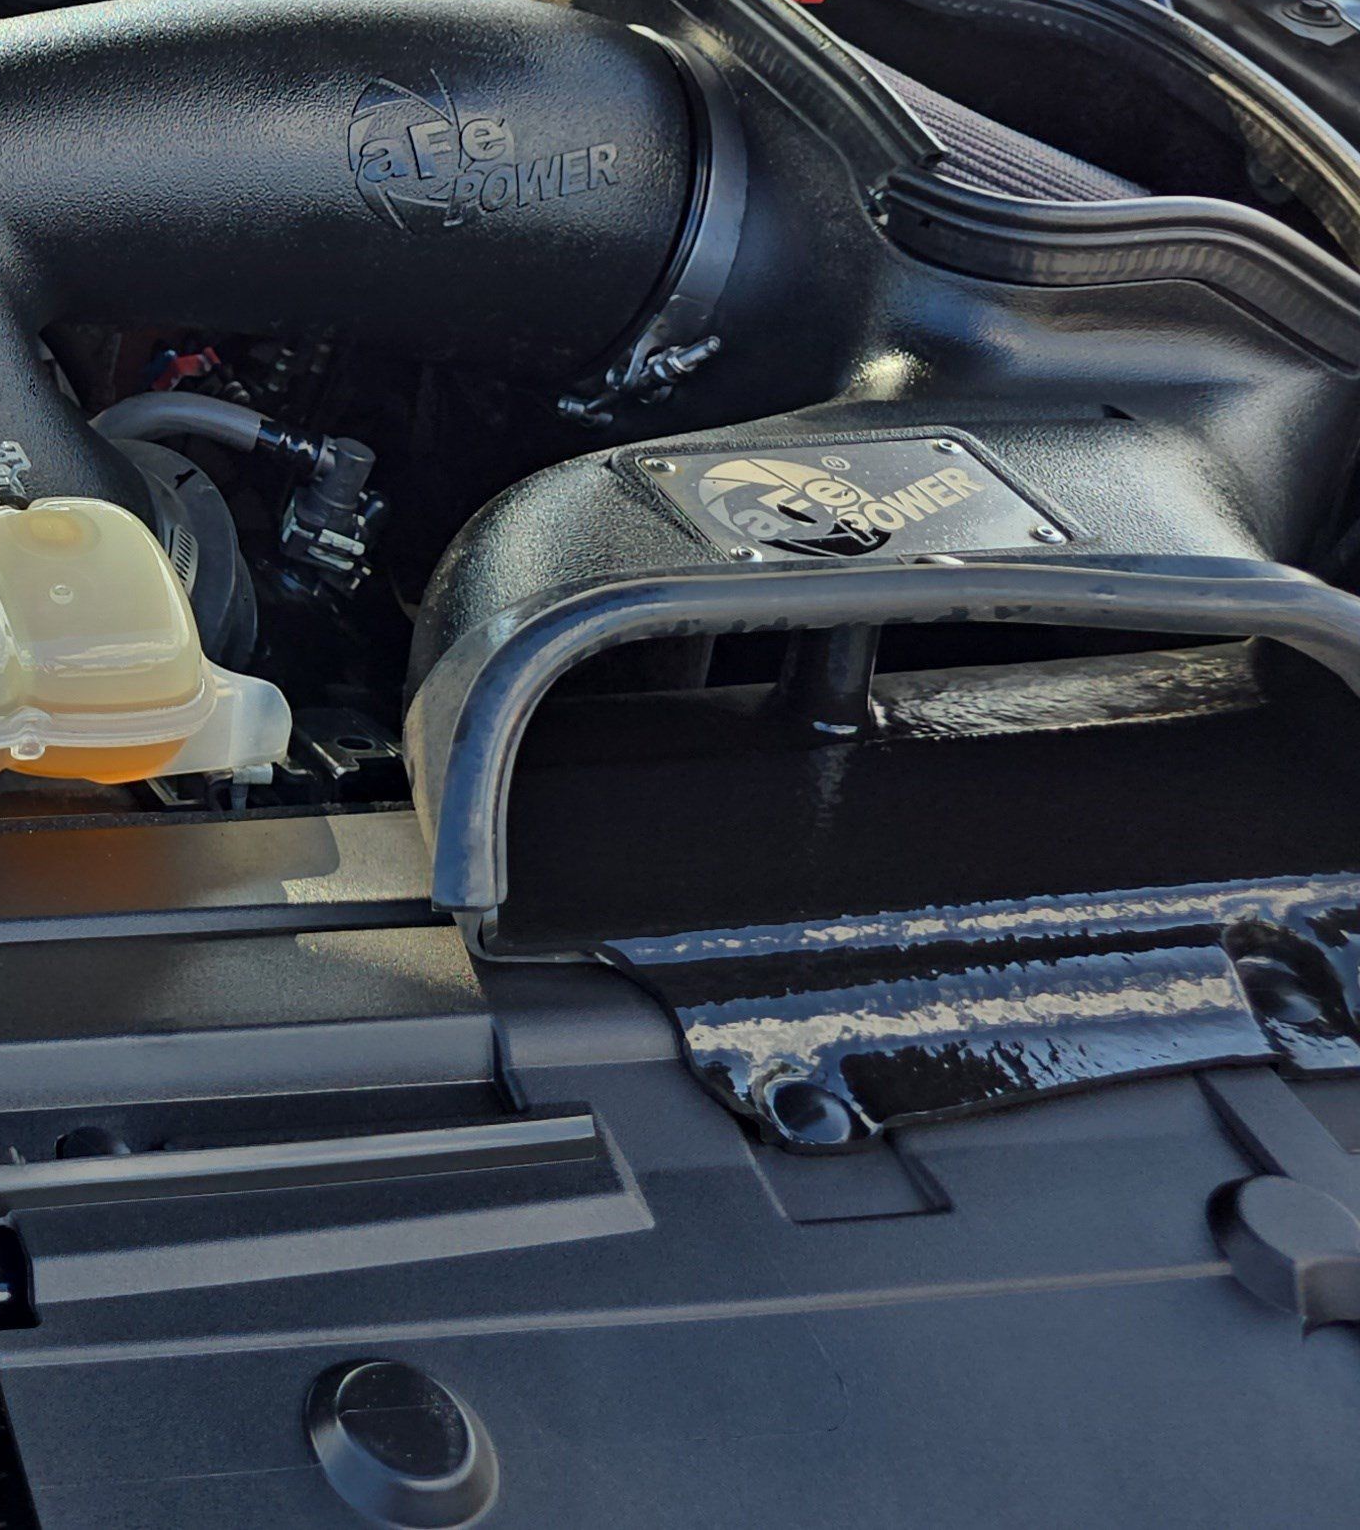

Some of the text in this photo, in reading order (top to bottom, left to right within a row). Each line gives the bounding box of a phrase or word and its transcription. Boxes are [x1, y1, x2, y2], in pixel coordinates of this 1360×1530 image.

[357, 117, 507, 183] aFe
[438, 142, 620, 227] POWER
[731, 477, 863, 539] aFe
[832, 466, 985, 547] POWER
